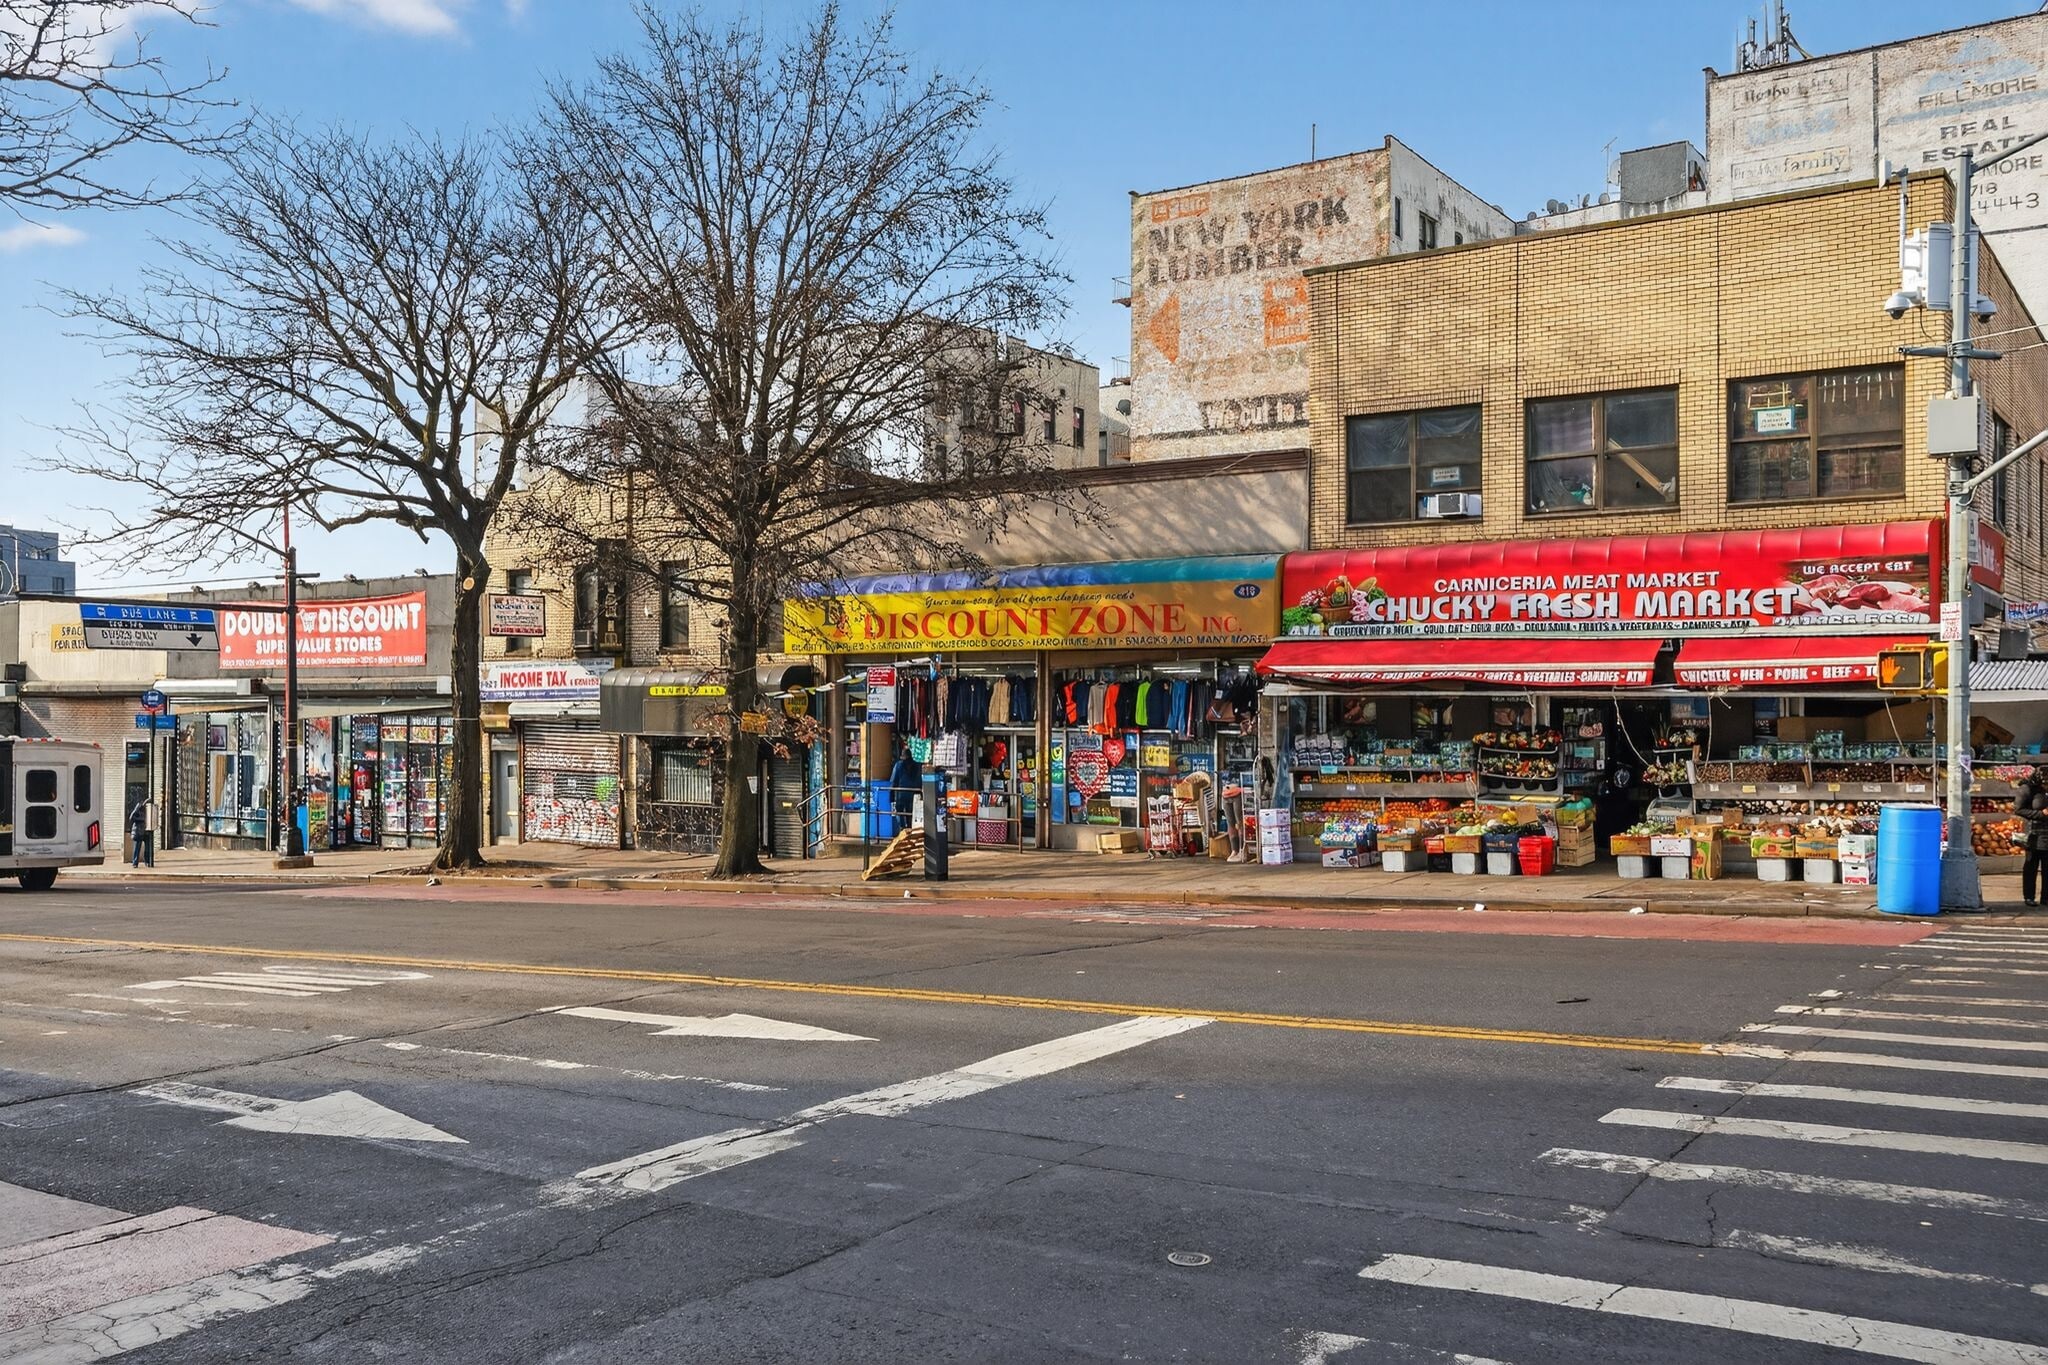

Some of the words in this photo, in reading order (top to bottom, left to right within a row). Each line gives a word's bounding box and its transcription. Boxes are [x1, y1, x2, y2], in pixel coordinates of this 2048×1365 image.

[1918, 75, 2037, 108] FILLMORE
[1940, 116, 2018, 139] REAL
[1150, 215, 1230, 252] NEW
[1241, 196, 1350, 240] YORK
[1803, 565, 1826, 574] WE
[1829, 563, 1881, 573] ACCEPT
[1885, 561, 1913, 571] EBT
[1434, 576, 1557, 593] CARNICERIA
[1563, 573, 1621, 589] MEAT
[1626, 571, 1720, 588] MARKET
[1368, 594, 1496, 622] CHUCKY
[1510, 592, 1621, 619] FRESH
[1635, 587, 1800, 618] MARKET
[318, 603, 421, 633] DISCOUNT
[864, 606, 1058, 640] DISCOUNT
[1070, 603, 1186, 636] ZONE
[1202, 616, 1243, 633] INC.
[335, 635, 383, 652] STORES
[1170, 635, 1193, 645] AND
[1197, 634, 1227, 645] MANY
[500, 670, 543, 688] INCOME
[546, 669, 568, 687] TAX
[1626, 670, 1648, 682] ATM
[1680, 669, 1731, 683] CHICKEN
[1774, 666, 1809, 680] PORK
[1822, 665, 1852, 679] BEEF
